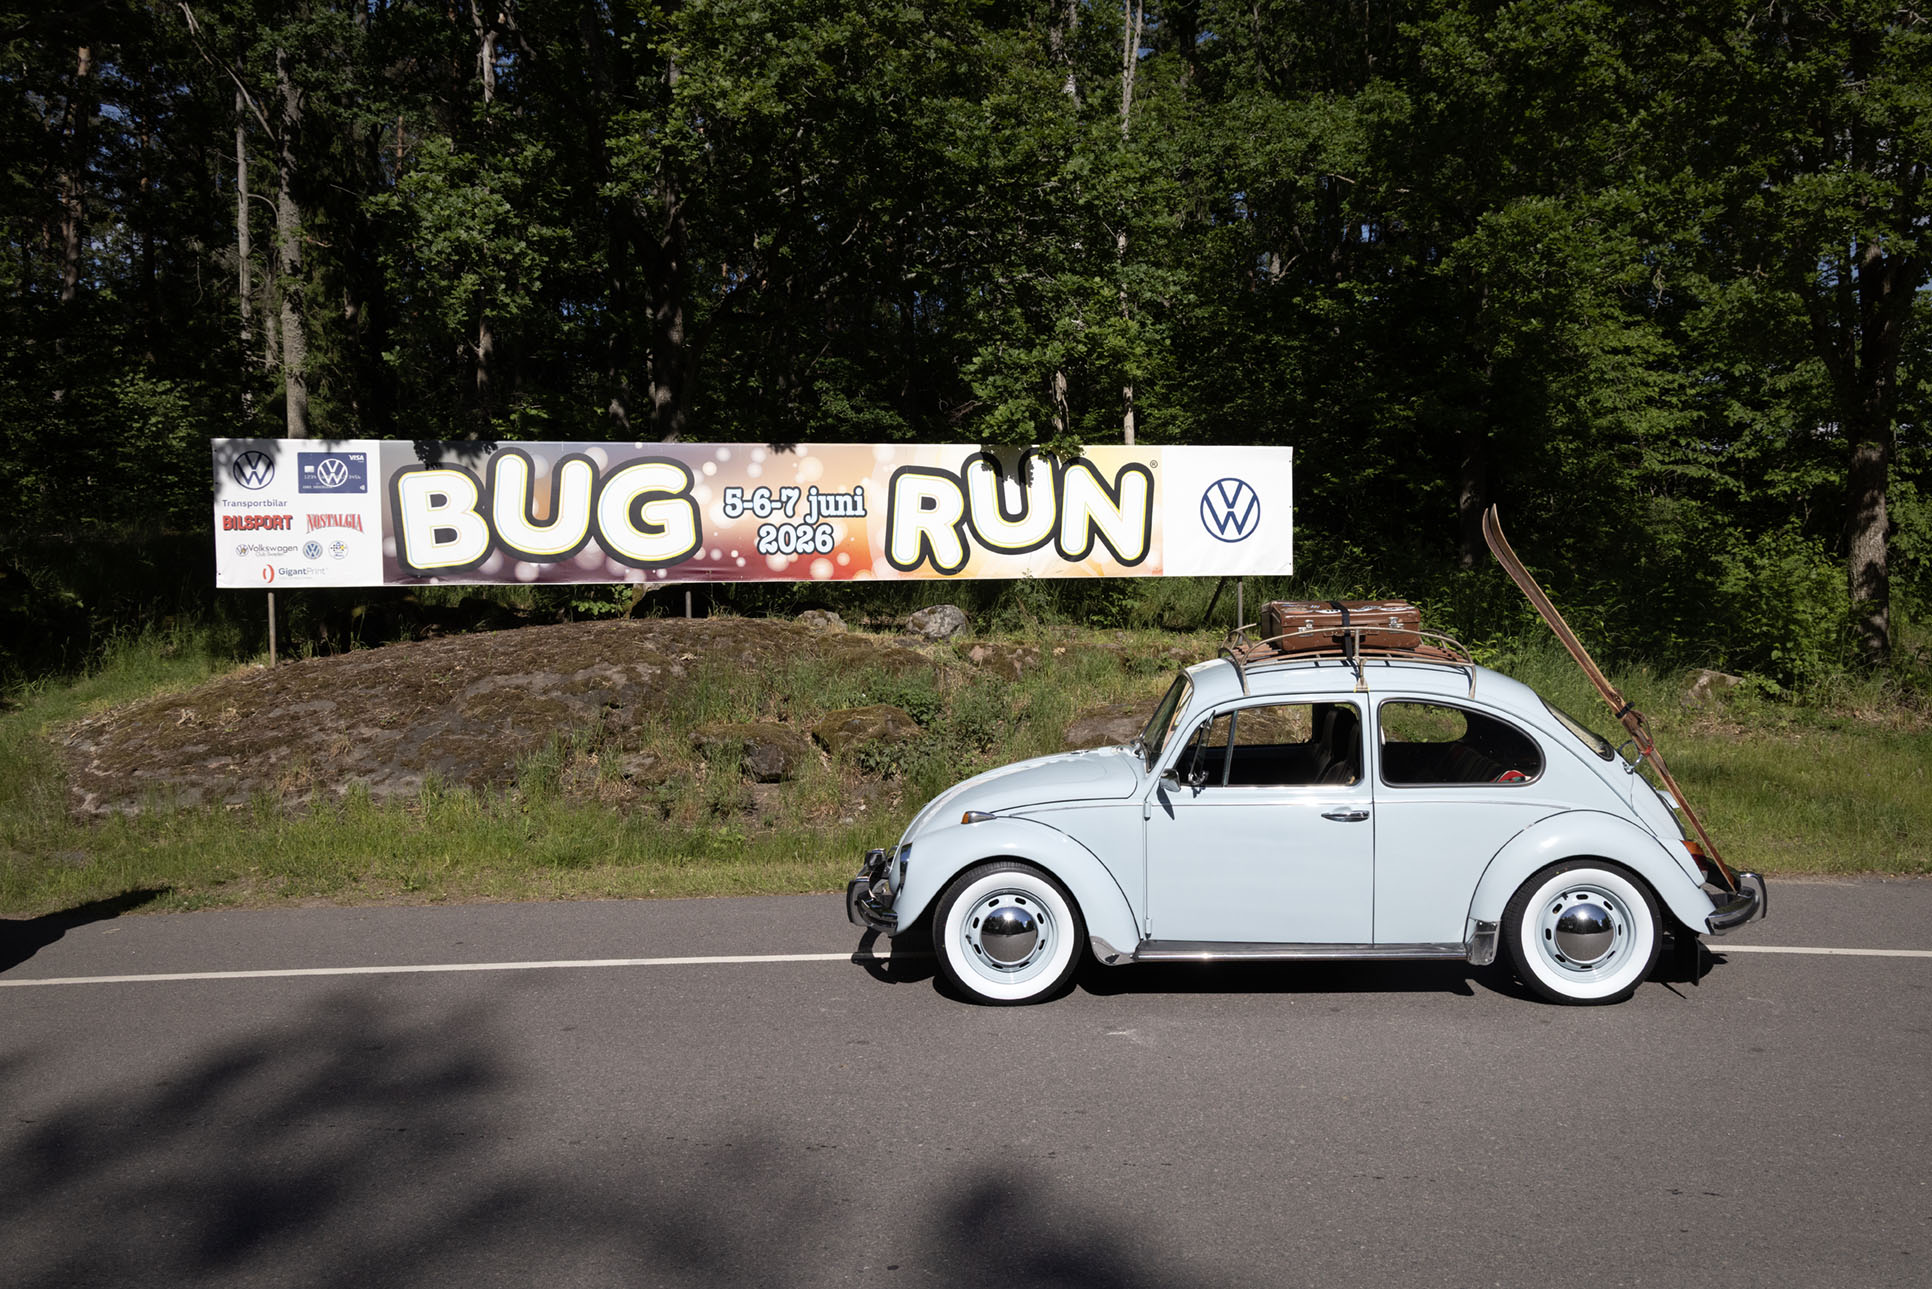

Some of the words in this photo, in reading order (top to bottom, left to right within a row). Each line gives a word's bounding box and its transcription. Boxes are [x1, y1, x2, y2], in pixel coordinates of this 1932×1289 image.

[222, 499, 288, 509] Transportbilar
[391, 449, 702, 573] BUG
[724, 486, 800, 518] 5-6-7
[806, 485, 868, 524] juni
[222, 514, 293, 531] BILSPORT
[306, 513, 365, 534] NOSTALGIA
[756, 523, 835, 555] 2026
[248, 544, 298, 554] Volkswagen
[278, 567, 326, 577] GigantPrint
